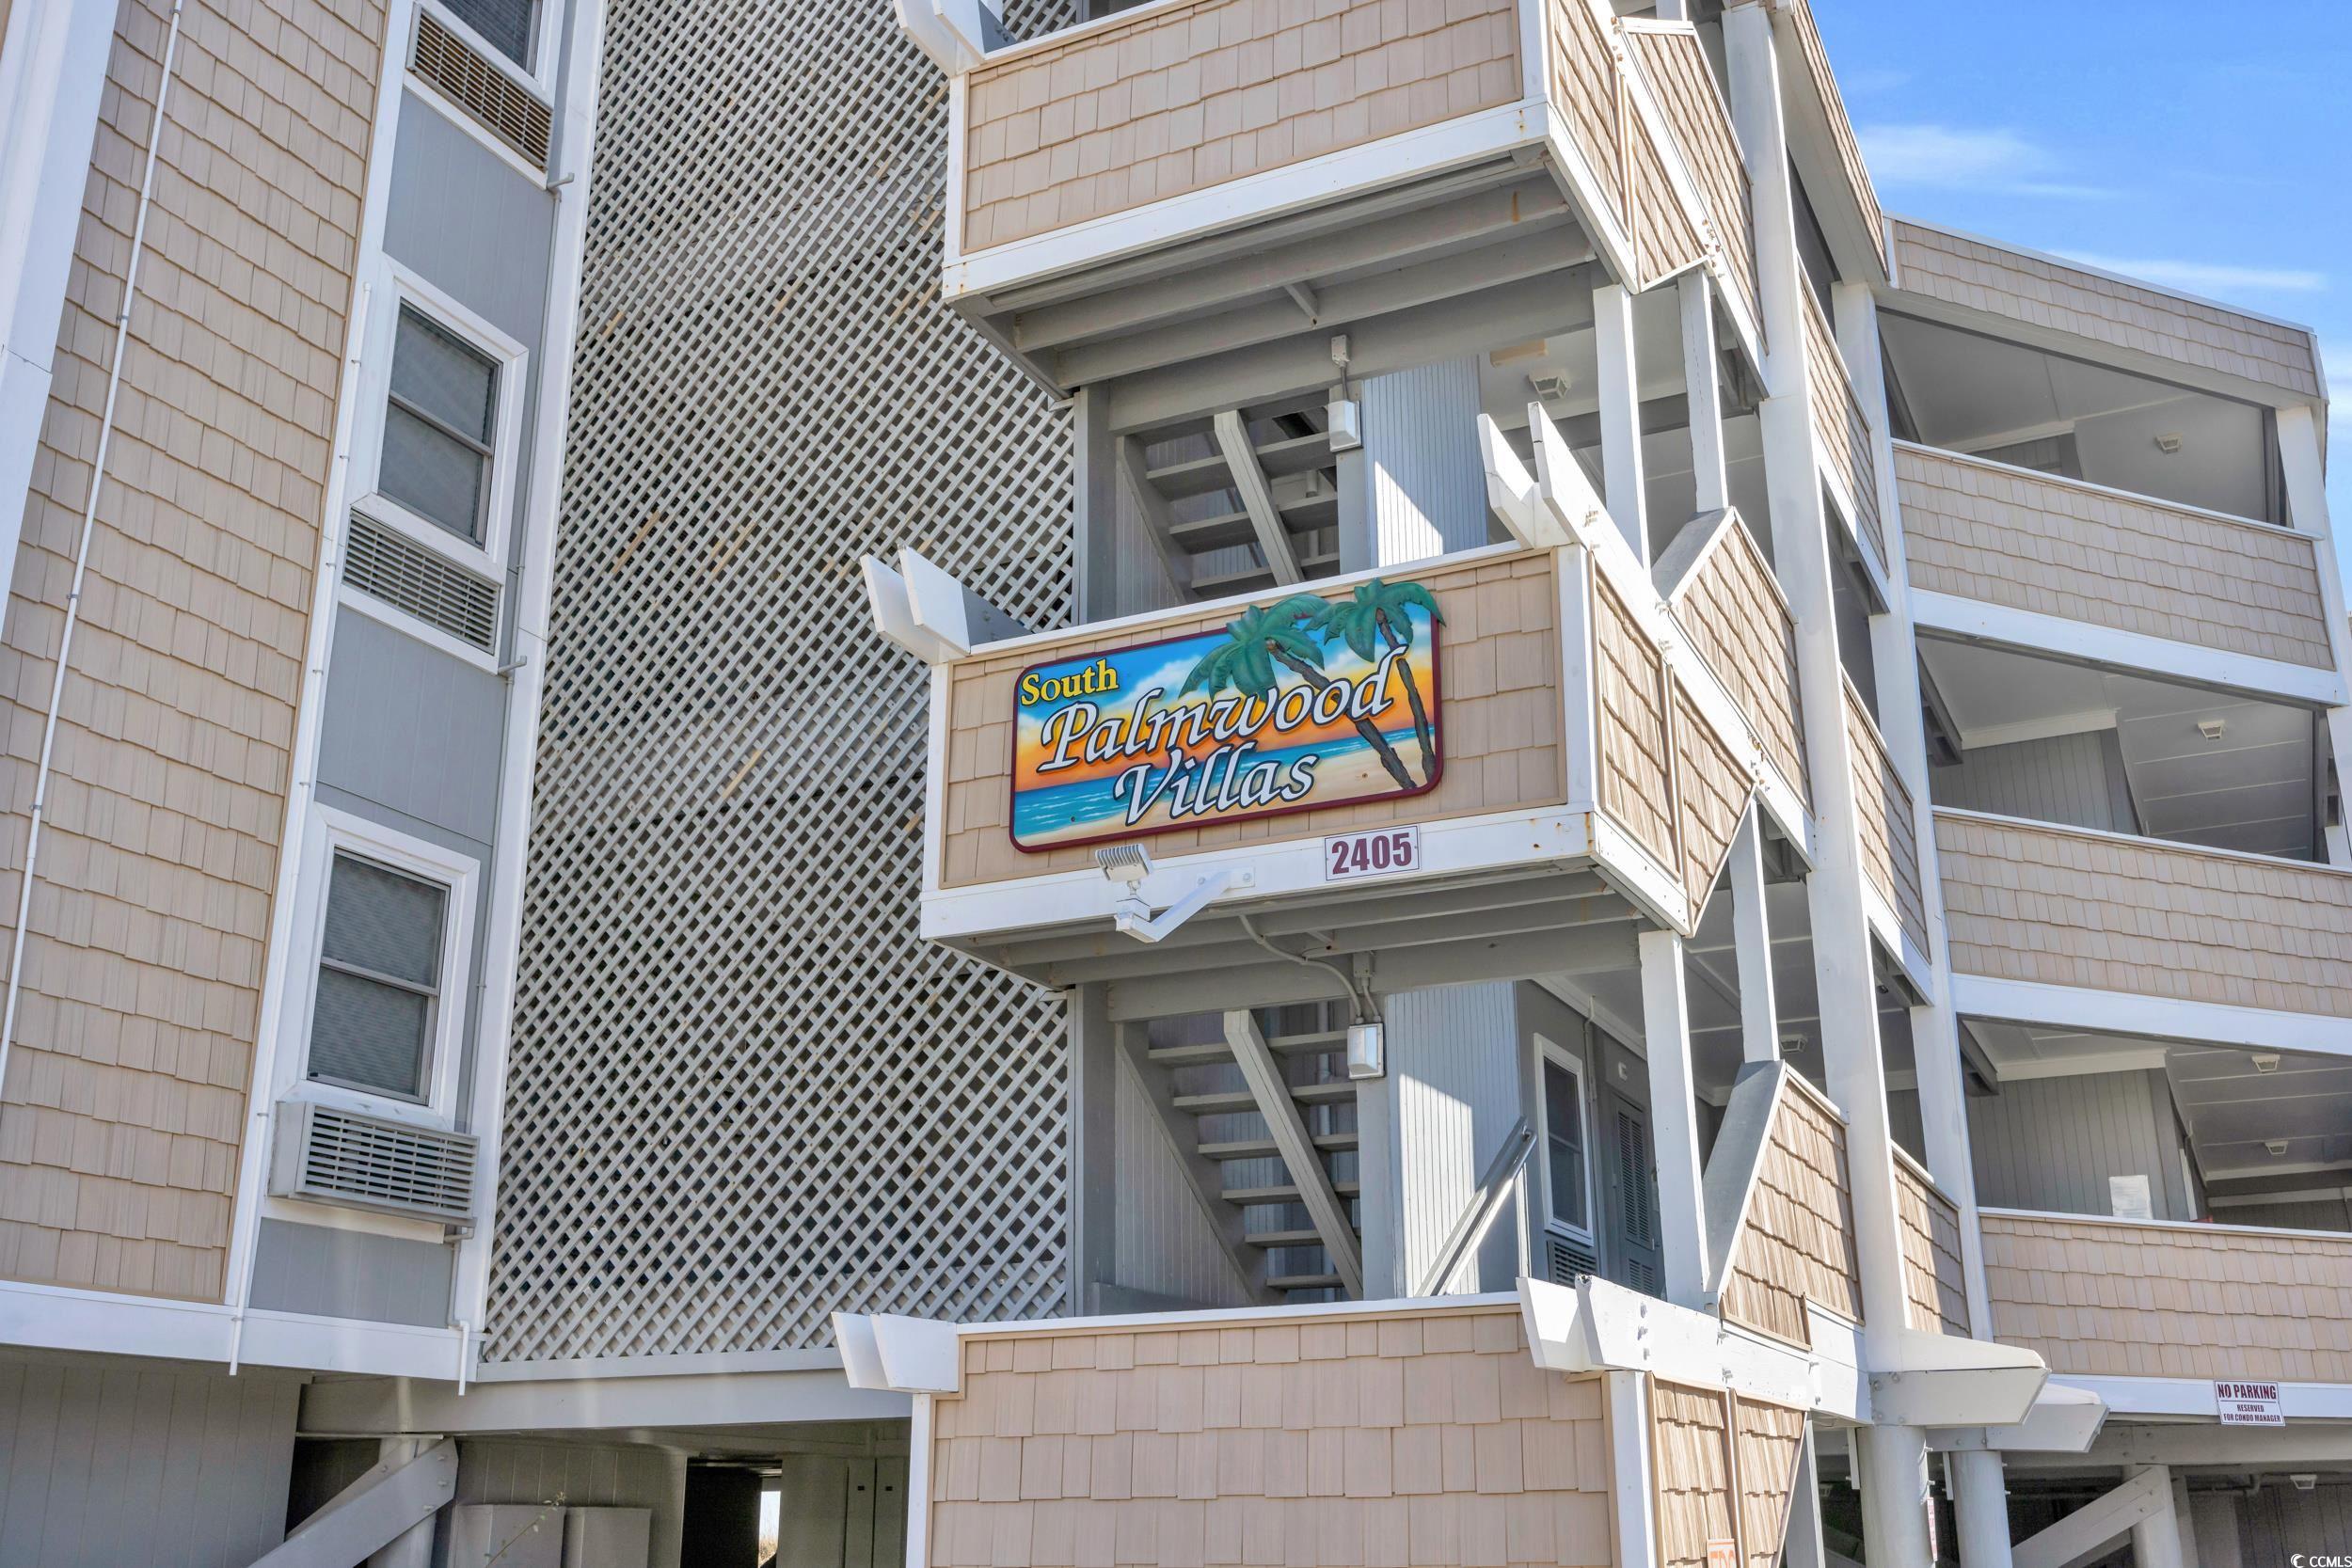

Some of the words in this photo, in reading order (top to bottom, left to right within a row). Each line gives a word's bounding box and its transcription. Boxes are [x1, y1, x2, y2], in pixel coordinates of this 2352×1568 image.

[1020, 659, 1120, 707] South
[1037, 645, 1408, 773] Palmwood
[1114, 739, 1319, 827] Villas
[1331, 832, 1411, 875] 2405
[2217, 1384, 2232, 1398] NO
[2233, 1385, 2277, 1399] PARKING
[2234, 1414, 2254, 1422] CONDO
[2254, 1415, 2281, 1423] MANAGER
